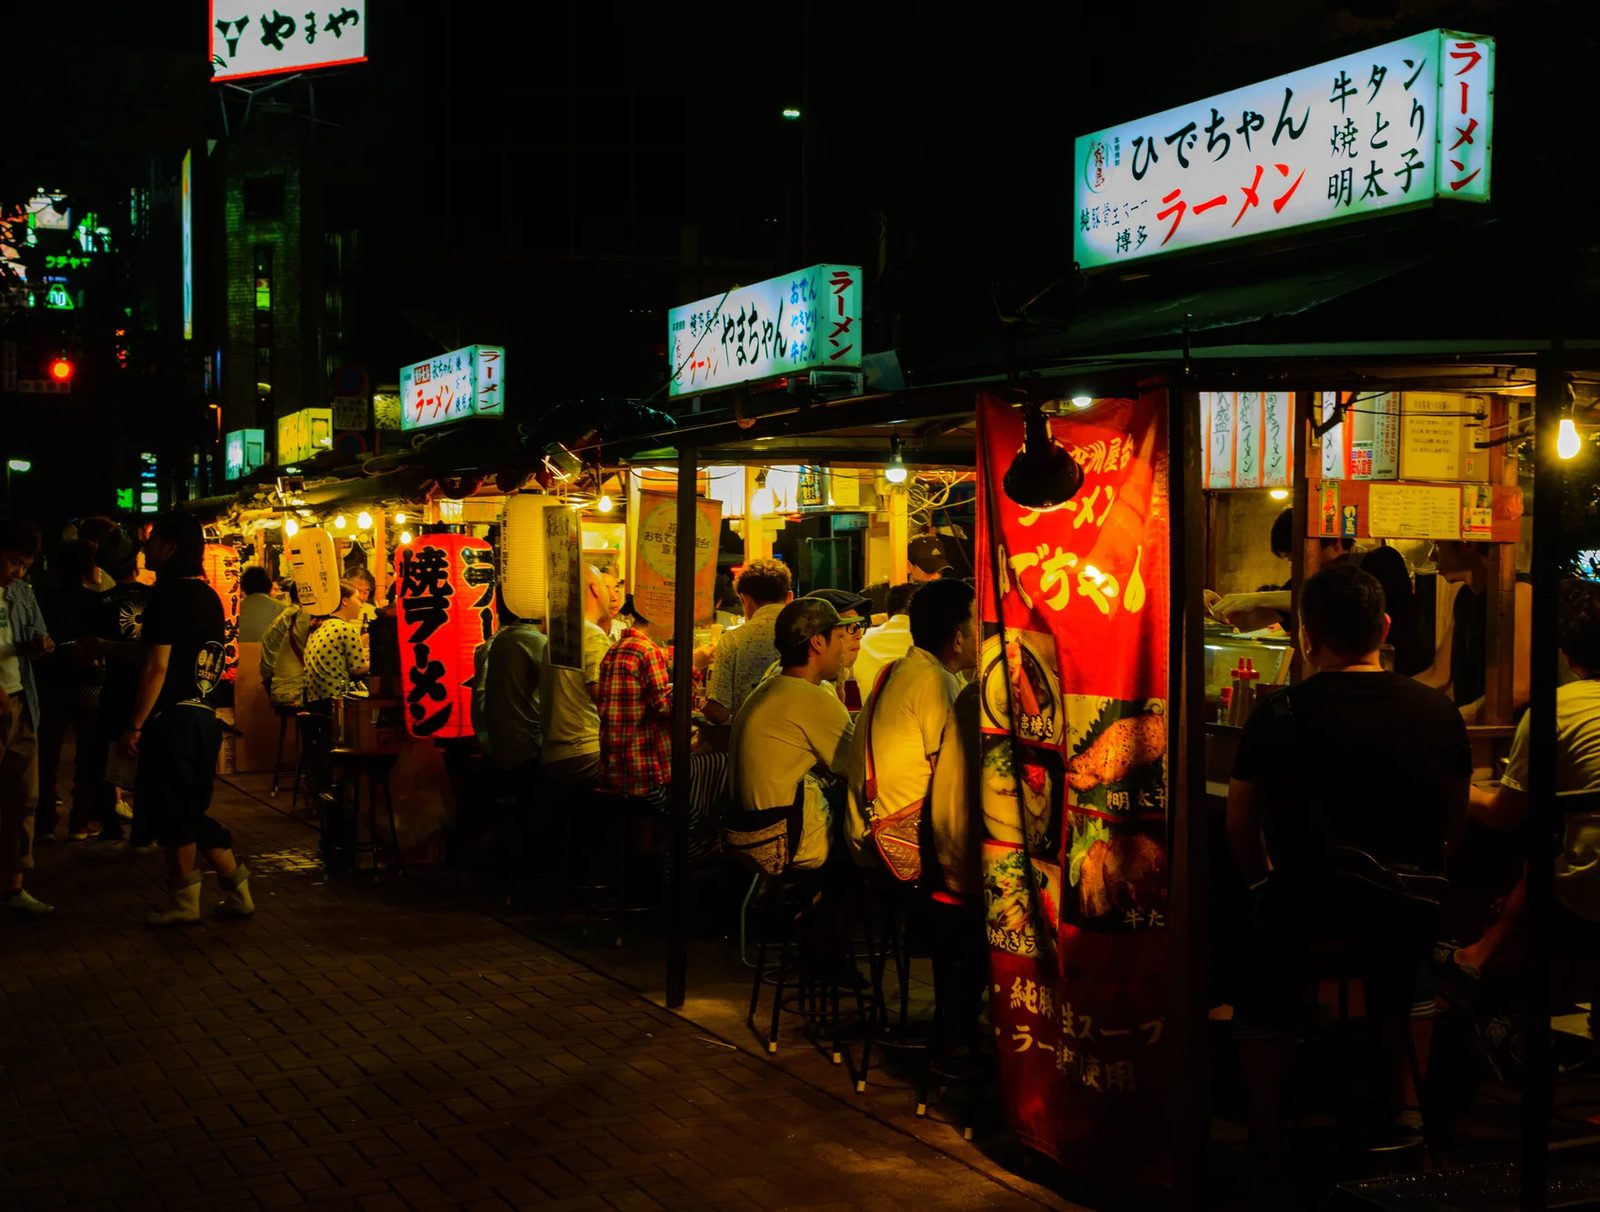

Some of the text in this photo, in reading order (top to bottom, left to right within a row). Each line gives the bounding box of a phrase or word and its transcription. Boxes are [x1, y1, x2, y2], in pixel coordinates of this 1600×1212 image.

[259, 7, 361, 52] やまや
[1328, 57, 1427, 115] 牛タン
[1131, 87, 1311, 183] ひでちゃん
[1330, 97, 1426, 159] 焼とり
[1449, 42, 1482, 192] ラーメン
[1156, 163, 1307, 248] ラーメン
[1327, 147, 1426, 208] 明太子
[1116, 225, 1149, 253] 博多
[791, 275, 817, 304] おでん
[829, 271, 854, 361] ラーメン
[721, 296, 787, 366] やまちゃん
[415, 385, 455, 422] ラーメン
[478, 350, 501, 411] ラーメン
[1017, 486, 1116, 529] ーメン
[398, 545, 456, 737] 焼ラーメン
[1019, 713, 1055, 739] 串焼き
